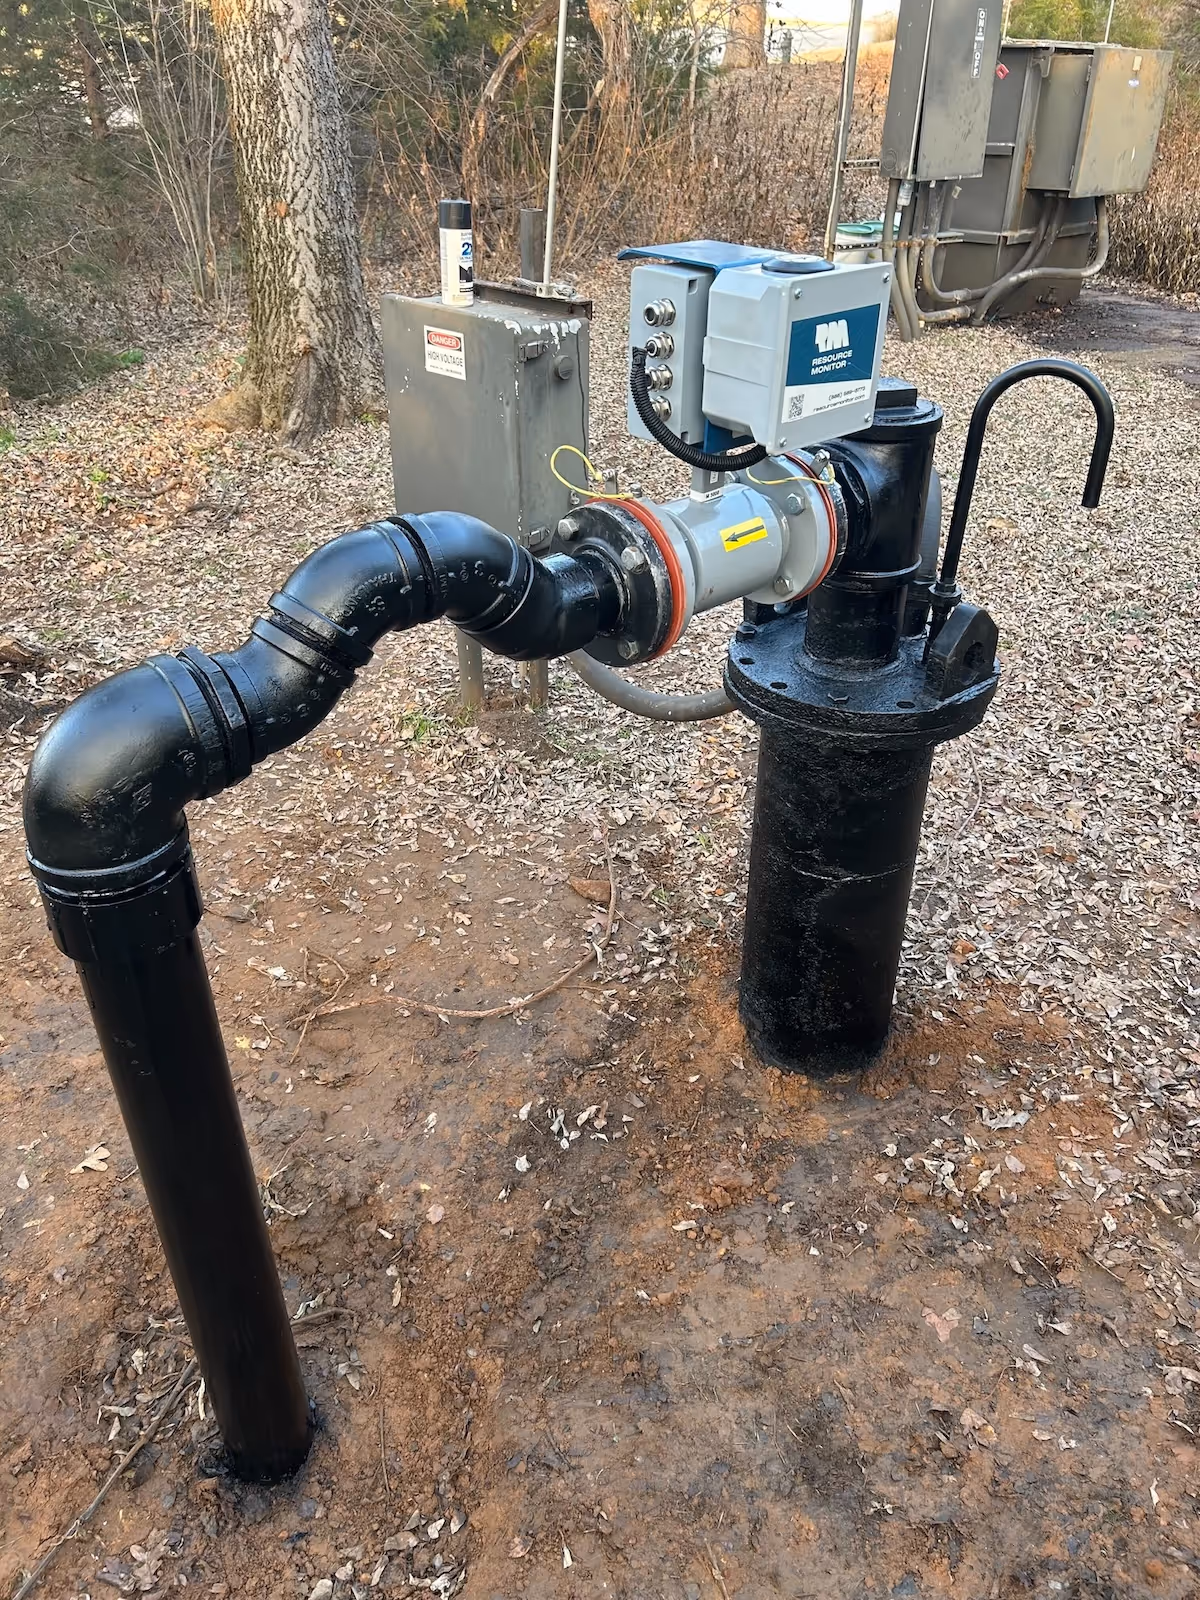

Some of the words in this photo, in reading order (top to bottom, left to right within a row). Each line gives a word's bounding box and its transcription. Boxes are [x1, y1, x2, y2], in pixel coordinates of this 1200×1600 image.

[978, 10, 986, 27] ON
[431, 334, 457, 348] DANGER
[428, 350, 439, 361] HIGH
[440, 353, 463, 368] VOLTAGE
[812, 350, 852, 366] RESOURCE
[811, 360, 846, 376] MONITOR
